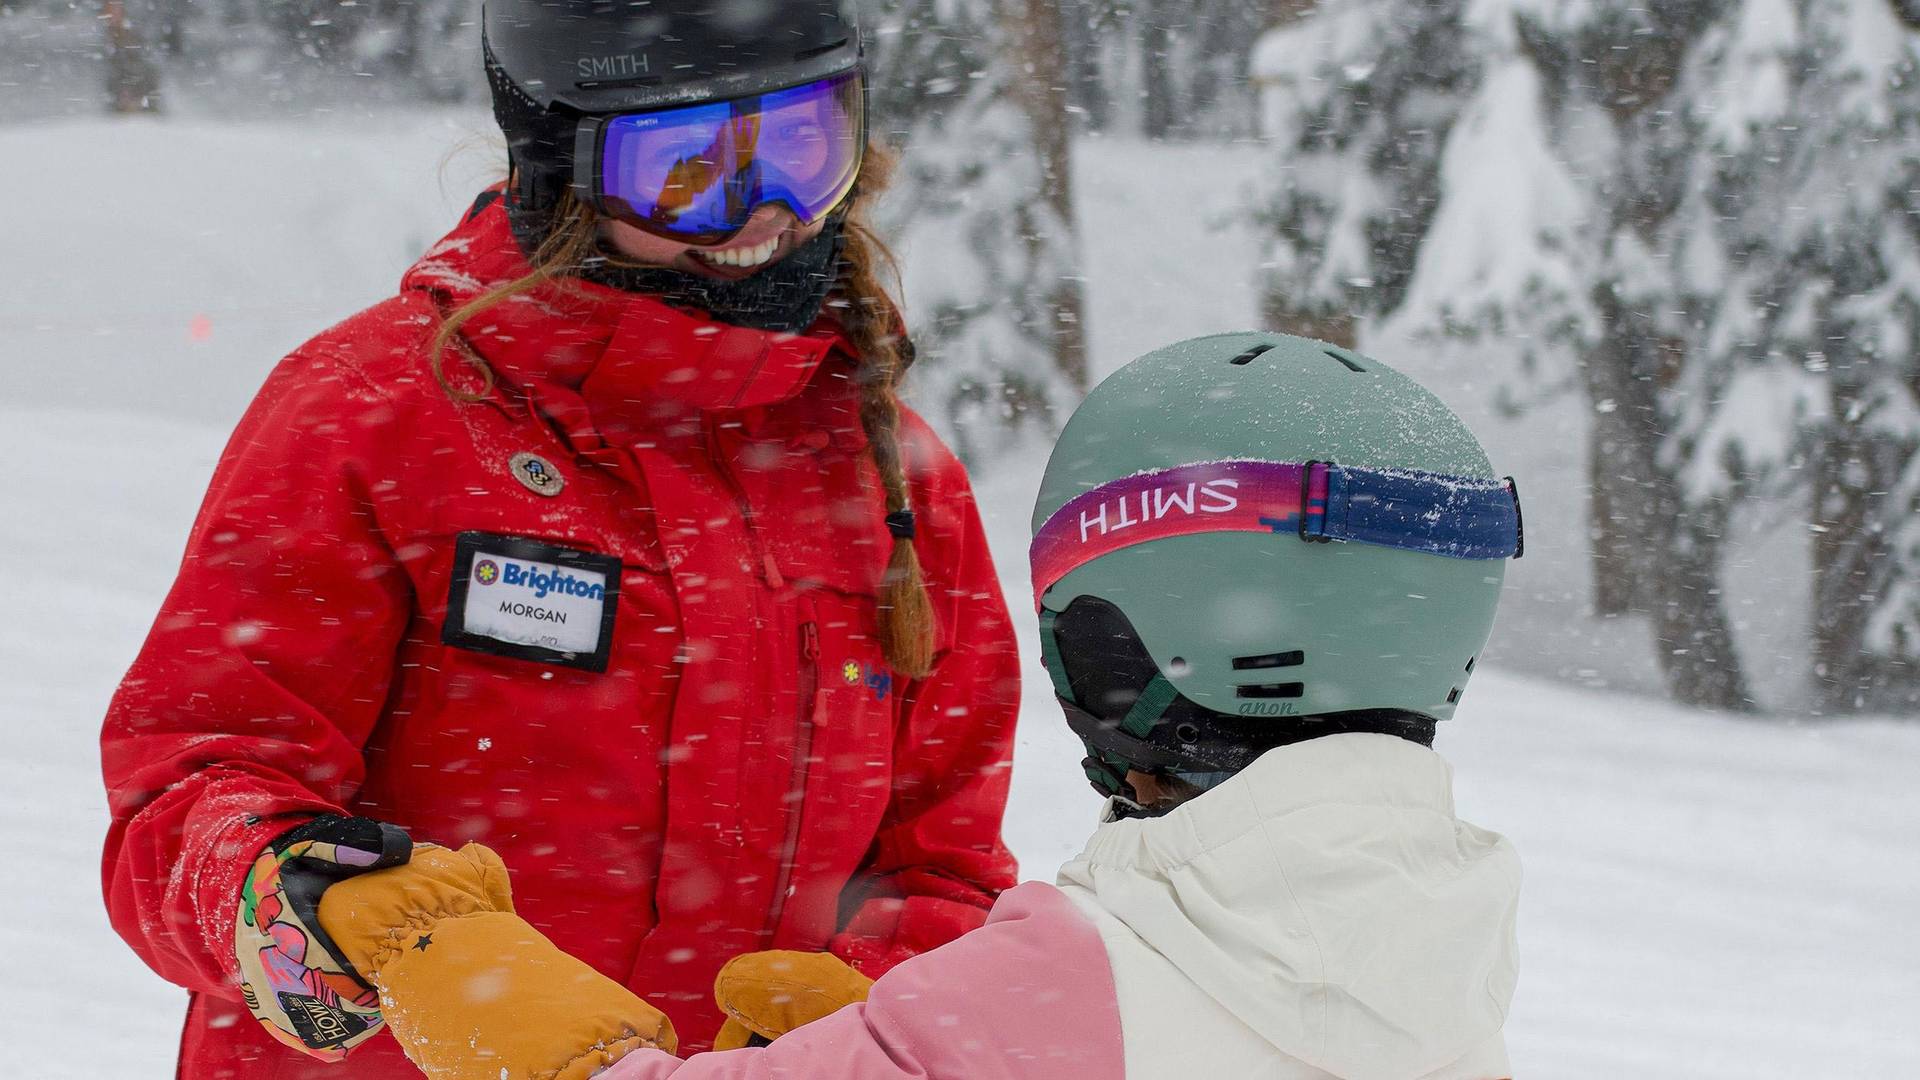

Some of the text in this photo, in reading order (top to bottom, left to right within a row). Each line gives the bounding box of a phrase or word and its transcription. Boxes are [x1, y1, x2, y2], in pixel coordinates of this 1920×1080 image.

[577, 54, 649, 77] SMITH
[636, 117, 658, 127] SMITH
[1080, 478, 1239, 543] SMITH
[503, 562, 605, 601] Brighton
[499, 601, 567, 624] MORGAN
[303, 998, 347, 1040] HOWL
